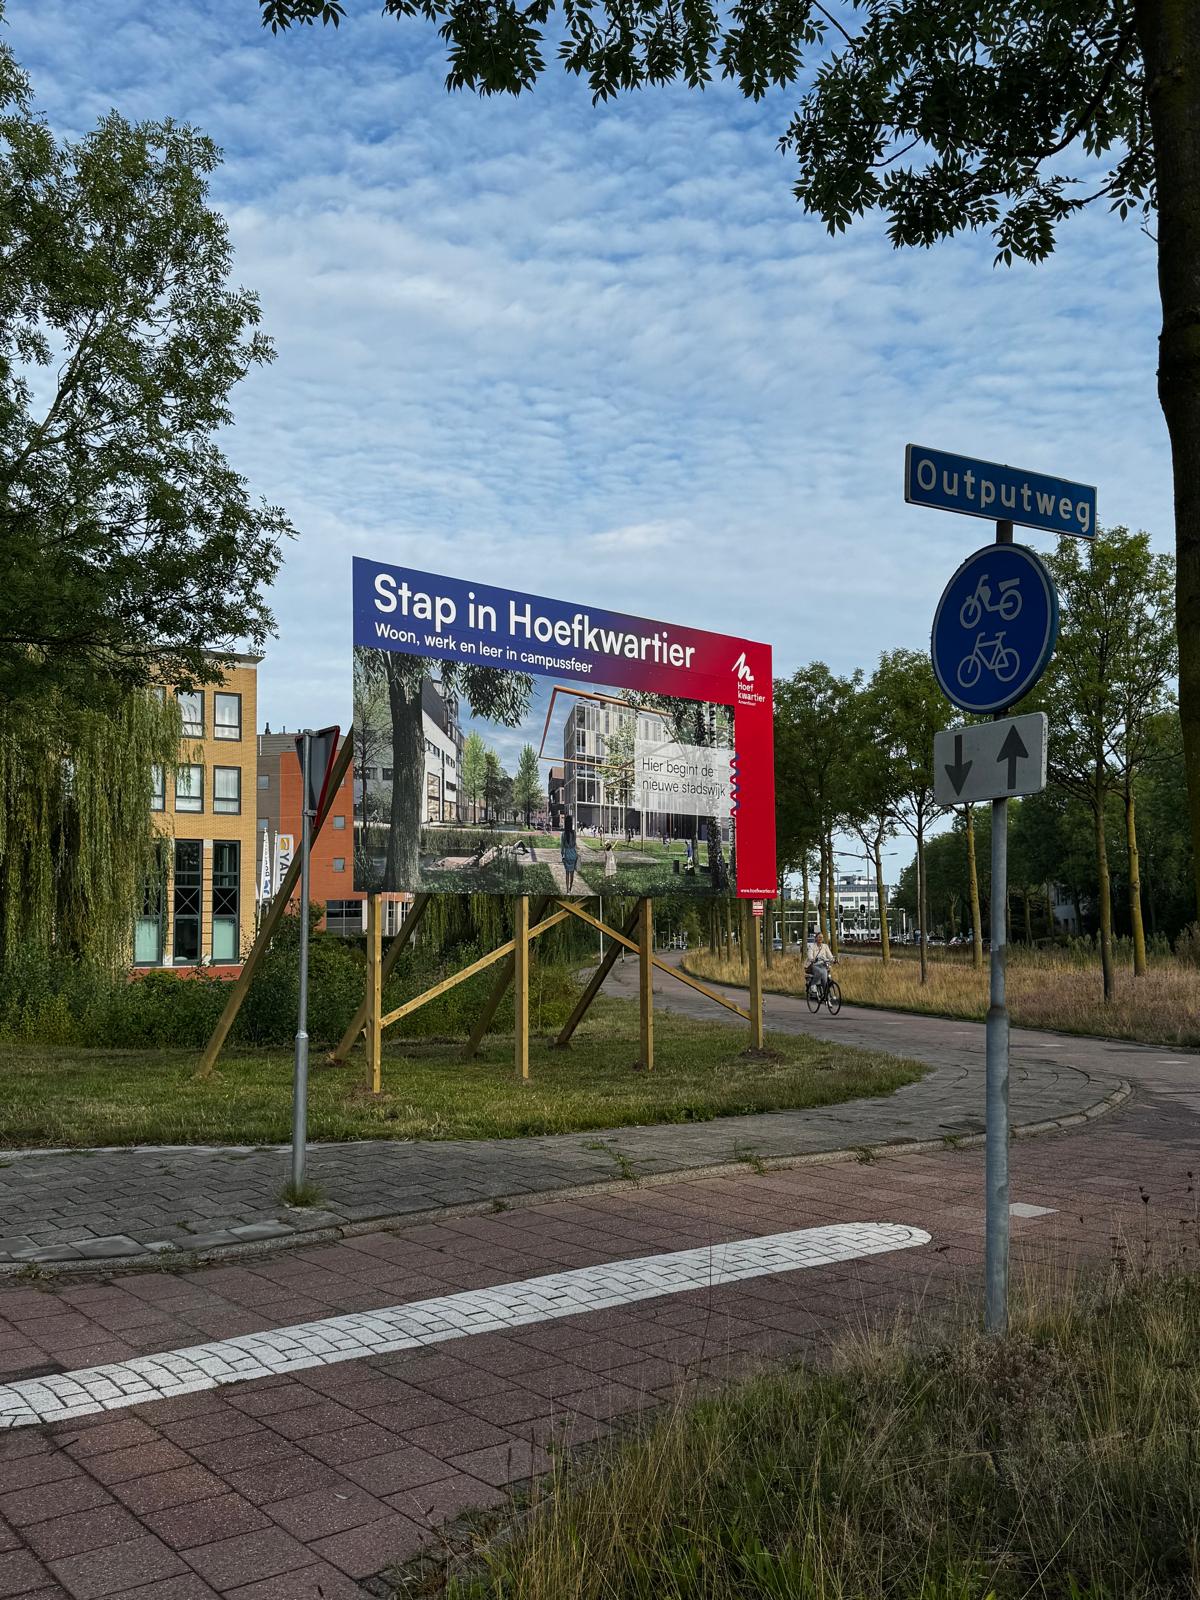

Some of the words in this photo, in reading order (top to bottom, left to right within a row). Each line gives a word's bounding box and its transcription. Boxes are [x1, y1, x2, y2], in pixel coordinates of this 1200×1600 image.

[917, 459, 1090, 533] Outputweg
[374, 573, 457, 632] Stap
[468, 591, 497, 632] in
[509, 600, 696, 668] Hoefkwartier
[374, 622, 420, 646] Woon,
[424, 634, 457, 650] werk
[460, 641, 475, 654] en
[480, 641, 503, 658] leer
[506, 646, 517, 661] in
[520, 651, 593, 674] campussfeer
[737, 681, 754, 692] Hoef
[737, 690, 765, 702] kwartier
[642, 757, 664, 772] Hier
[666, 759, 699, 778] begint
[701, 764, 714, 777] de
[642, 776, 679, 793] nieuwe
[681, 781, 726, 800] stadswijk
